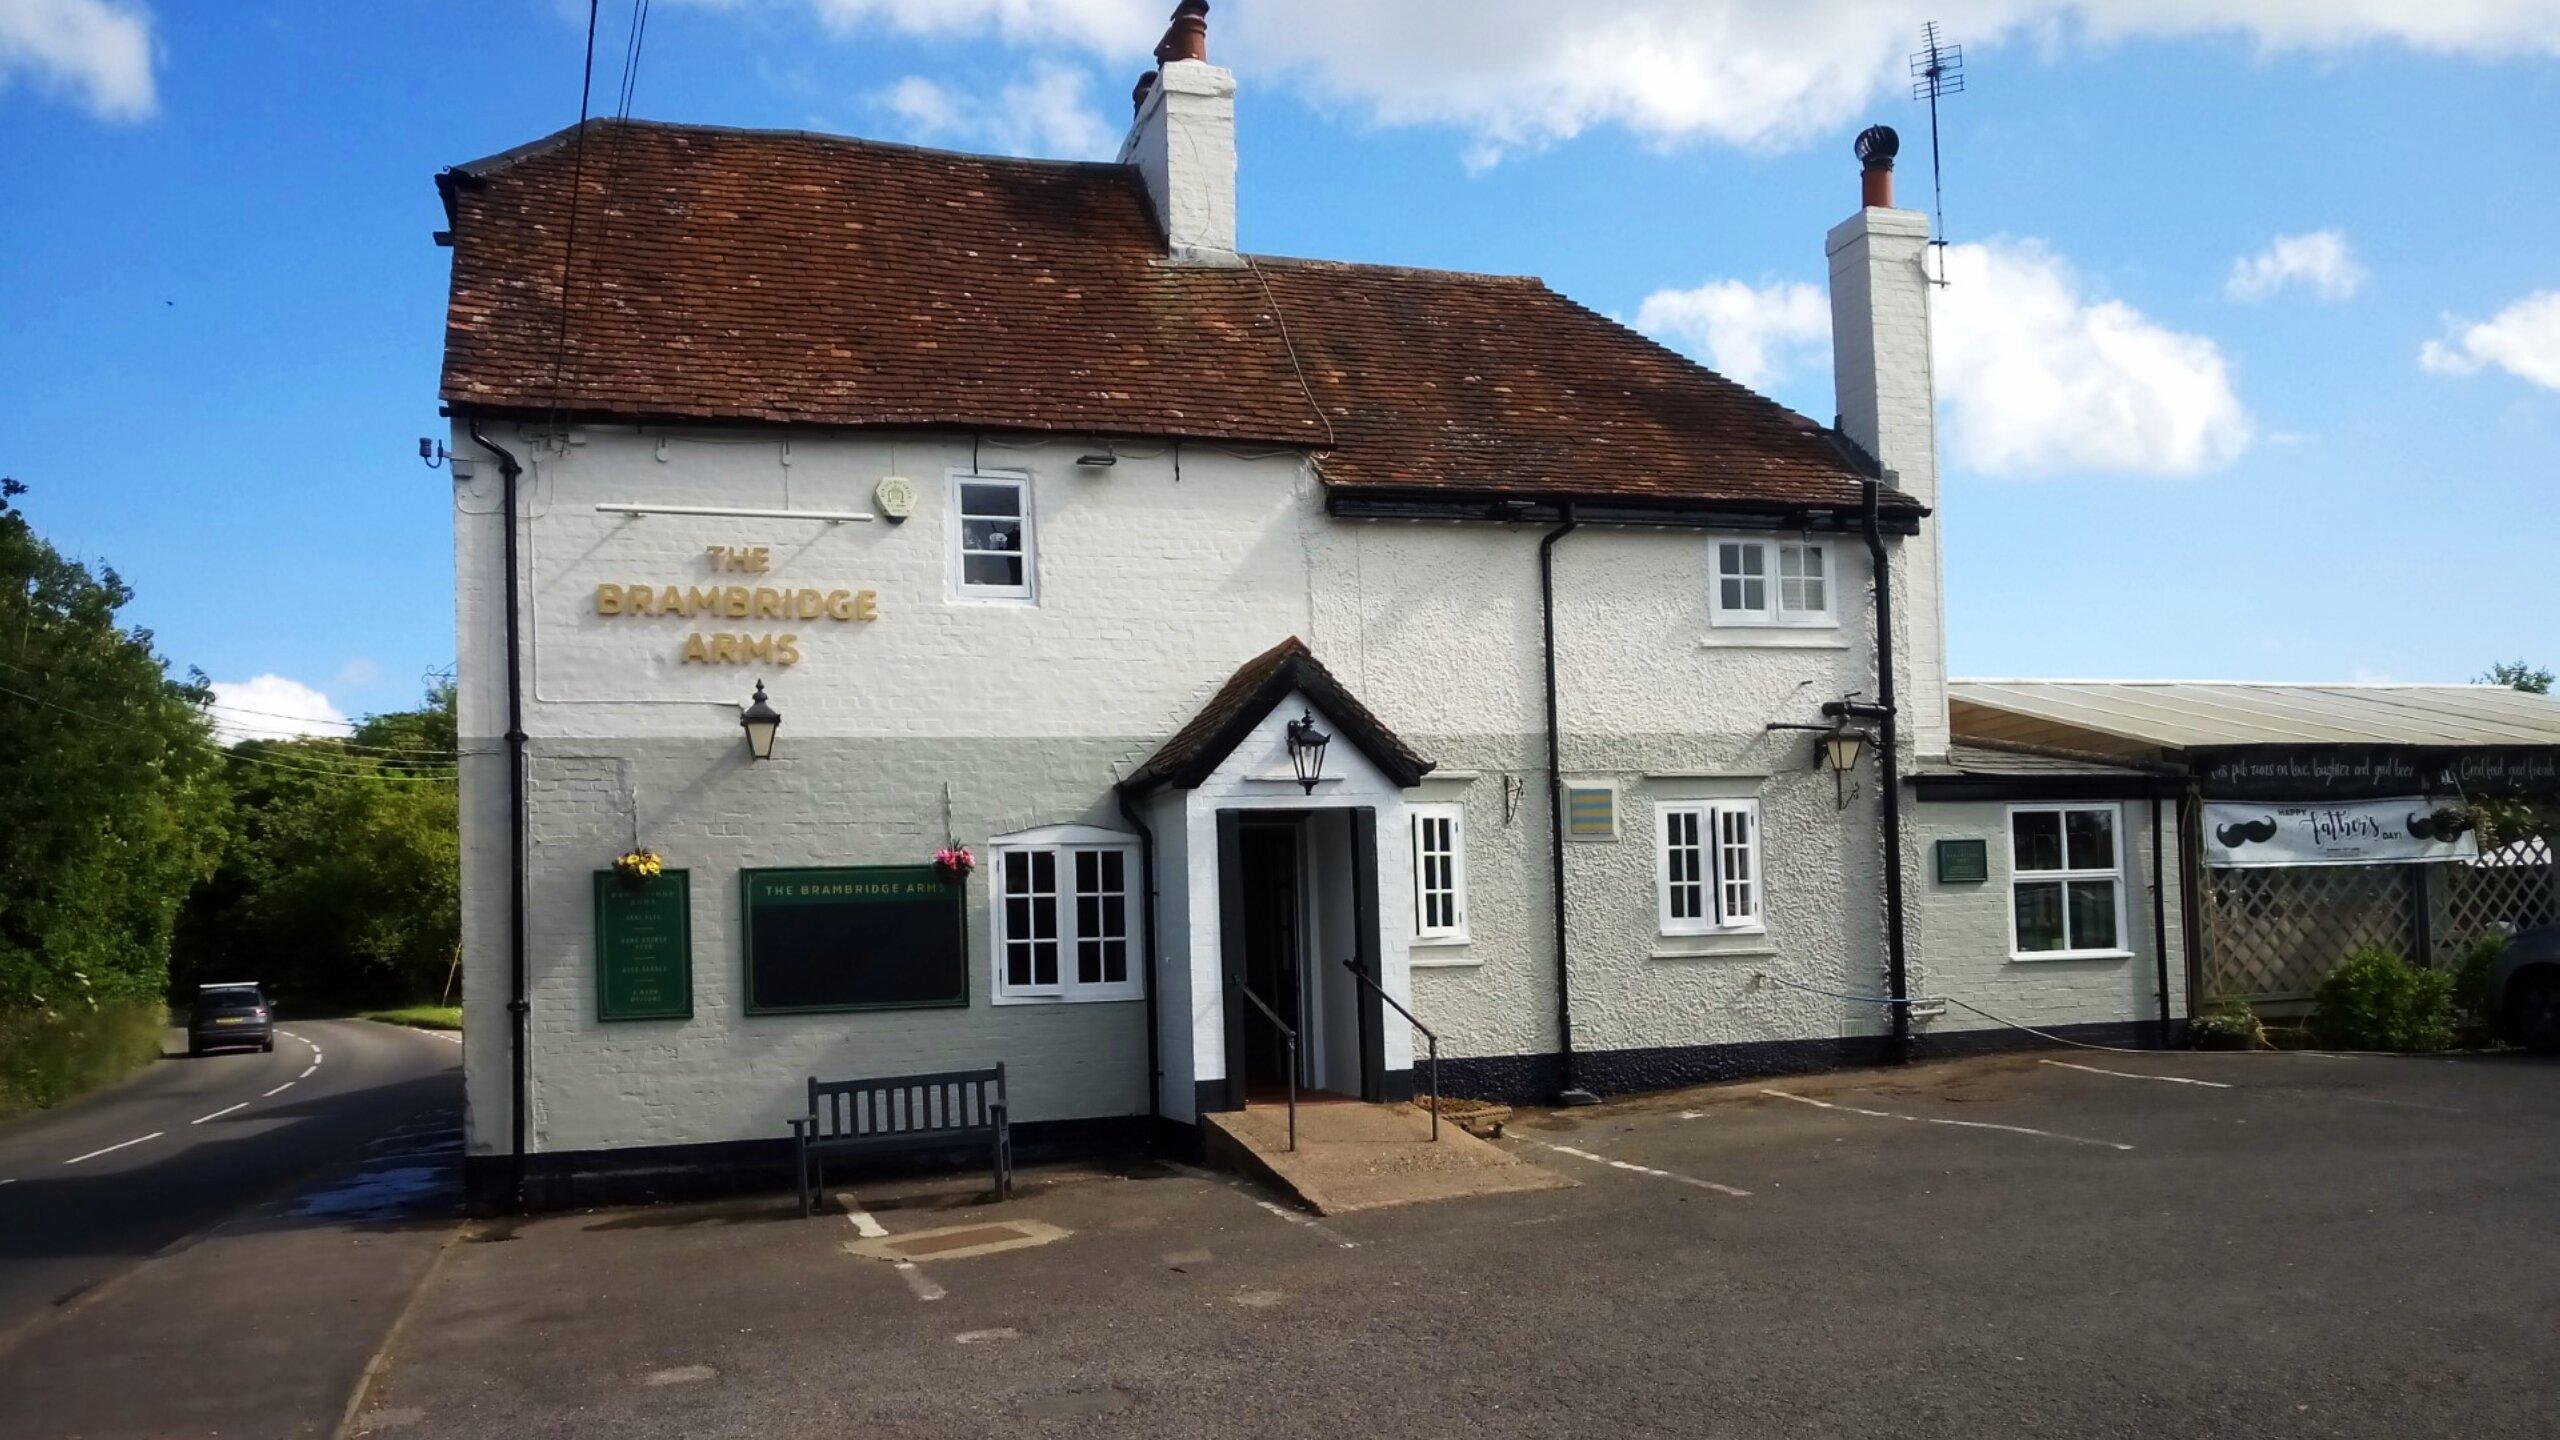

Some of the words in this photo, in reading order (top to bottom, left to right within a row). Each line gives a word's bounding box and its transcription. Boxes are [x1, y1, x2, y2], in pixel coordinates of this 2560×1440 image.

[706, 545, 770, 572] THE
[597, 583, 878, 620] BRAMBRIDGE
[682, 632, 800, 665] ARMS
[2354, 756, 2370, 776] and
[2277, 808, 2307, 817] HAPPY
[2382, 831, 2402, 841] DAY!
[766, 885, 794, 896] THE
[801, 883, 900, 896] BRAMBRIDGE
